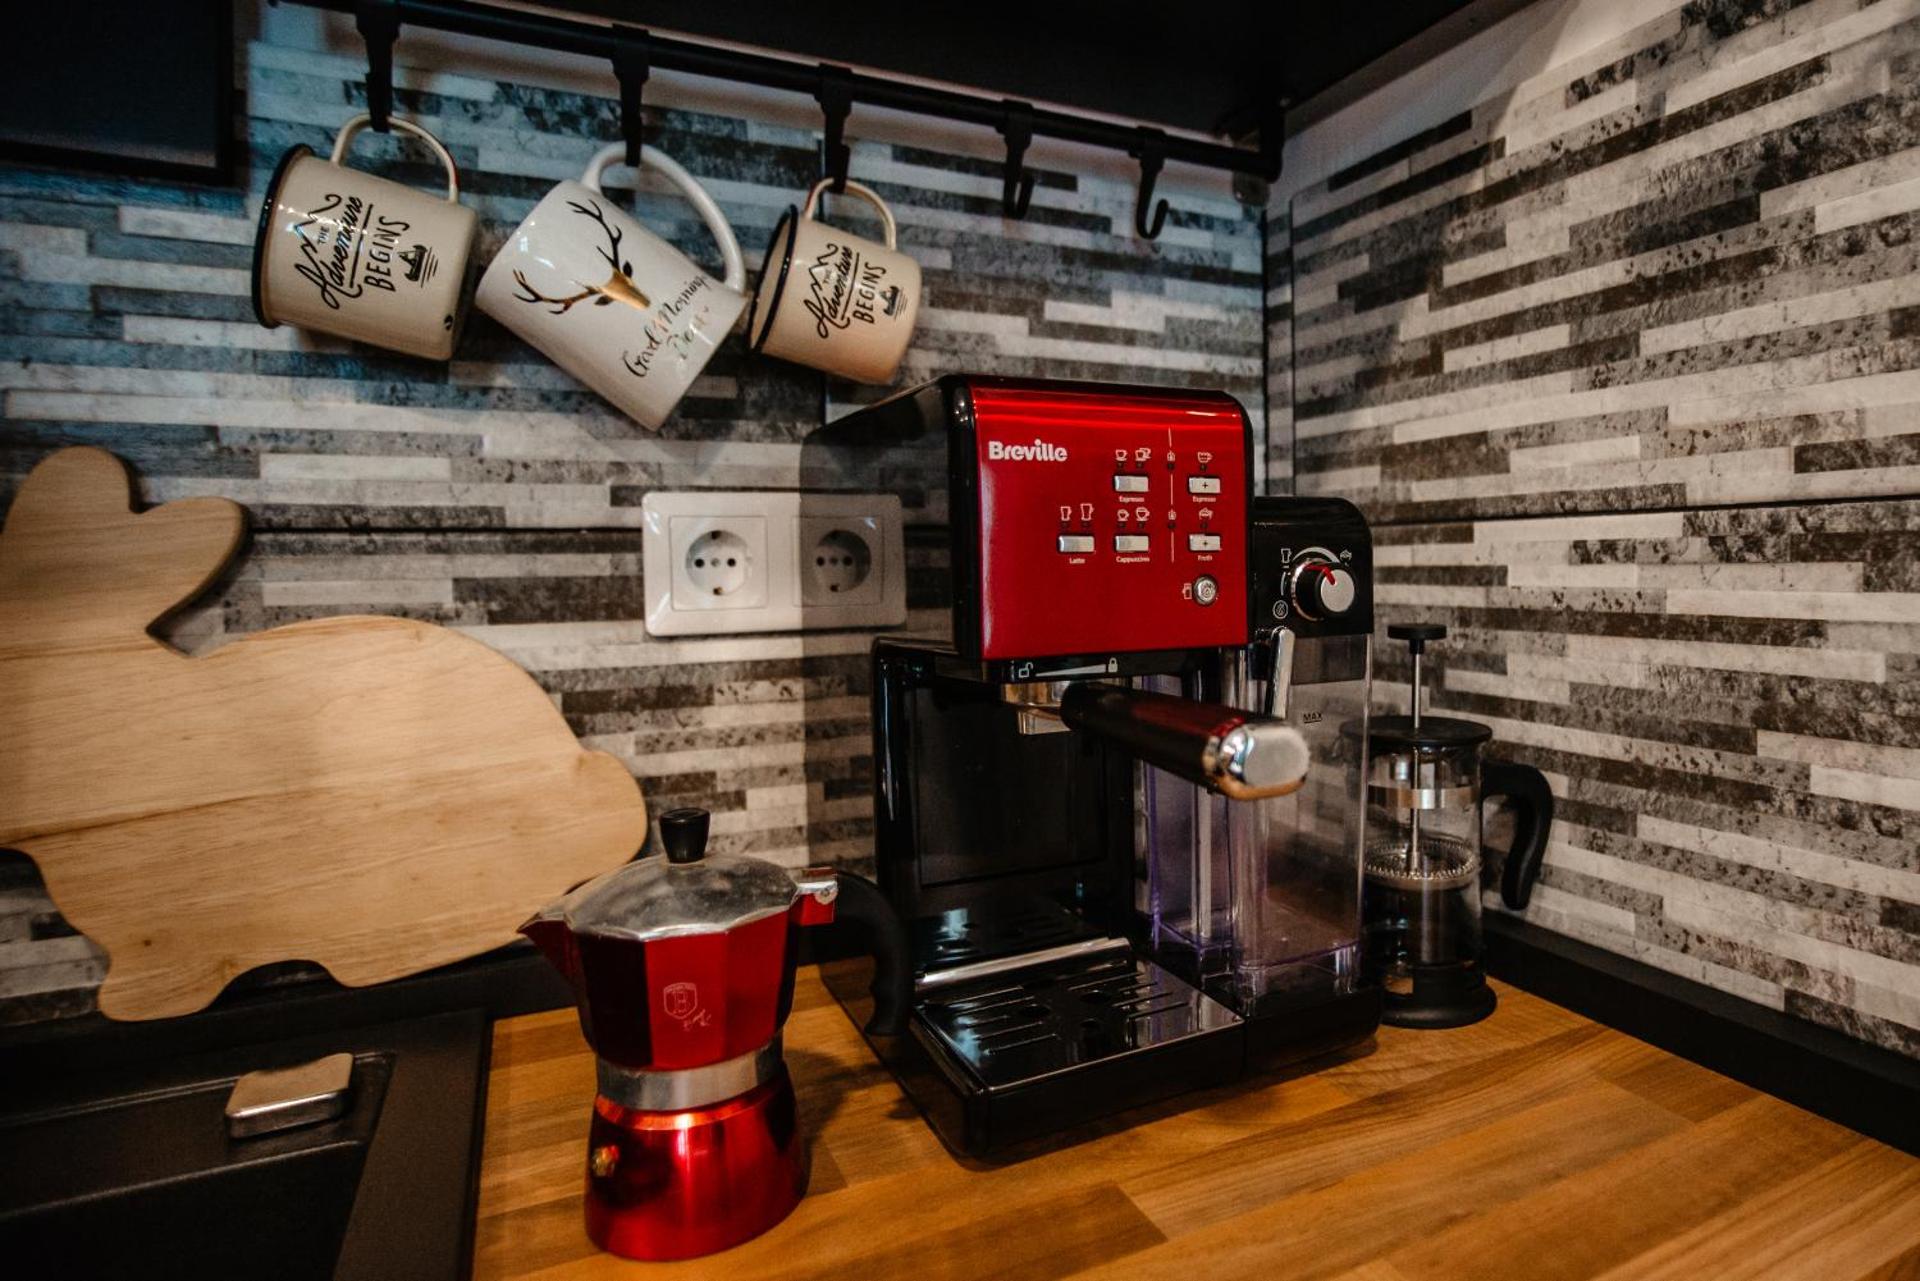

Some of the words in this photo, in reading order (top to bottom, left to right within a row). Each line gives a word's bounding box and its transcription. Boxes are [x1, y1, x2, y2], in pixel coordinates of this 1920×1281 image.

[294, 195, 363, 309] Adventure
[318, 226, 330, 245] THE
[364, 216, 410, 292] BEGINS
[803, 244, 853, 339] Adventure
[852, 262, 887, 324] BEGINS
[622, 326, 661, 378] Good
[653, 275, 712, 333] Morning
[988, 438, 1068, 462] Breville
[1303, 712, 1322, 721] MAX
